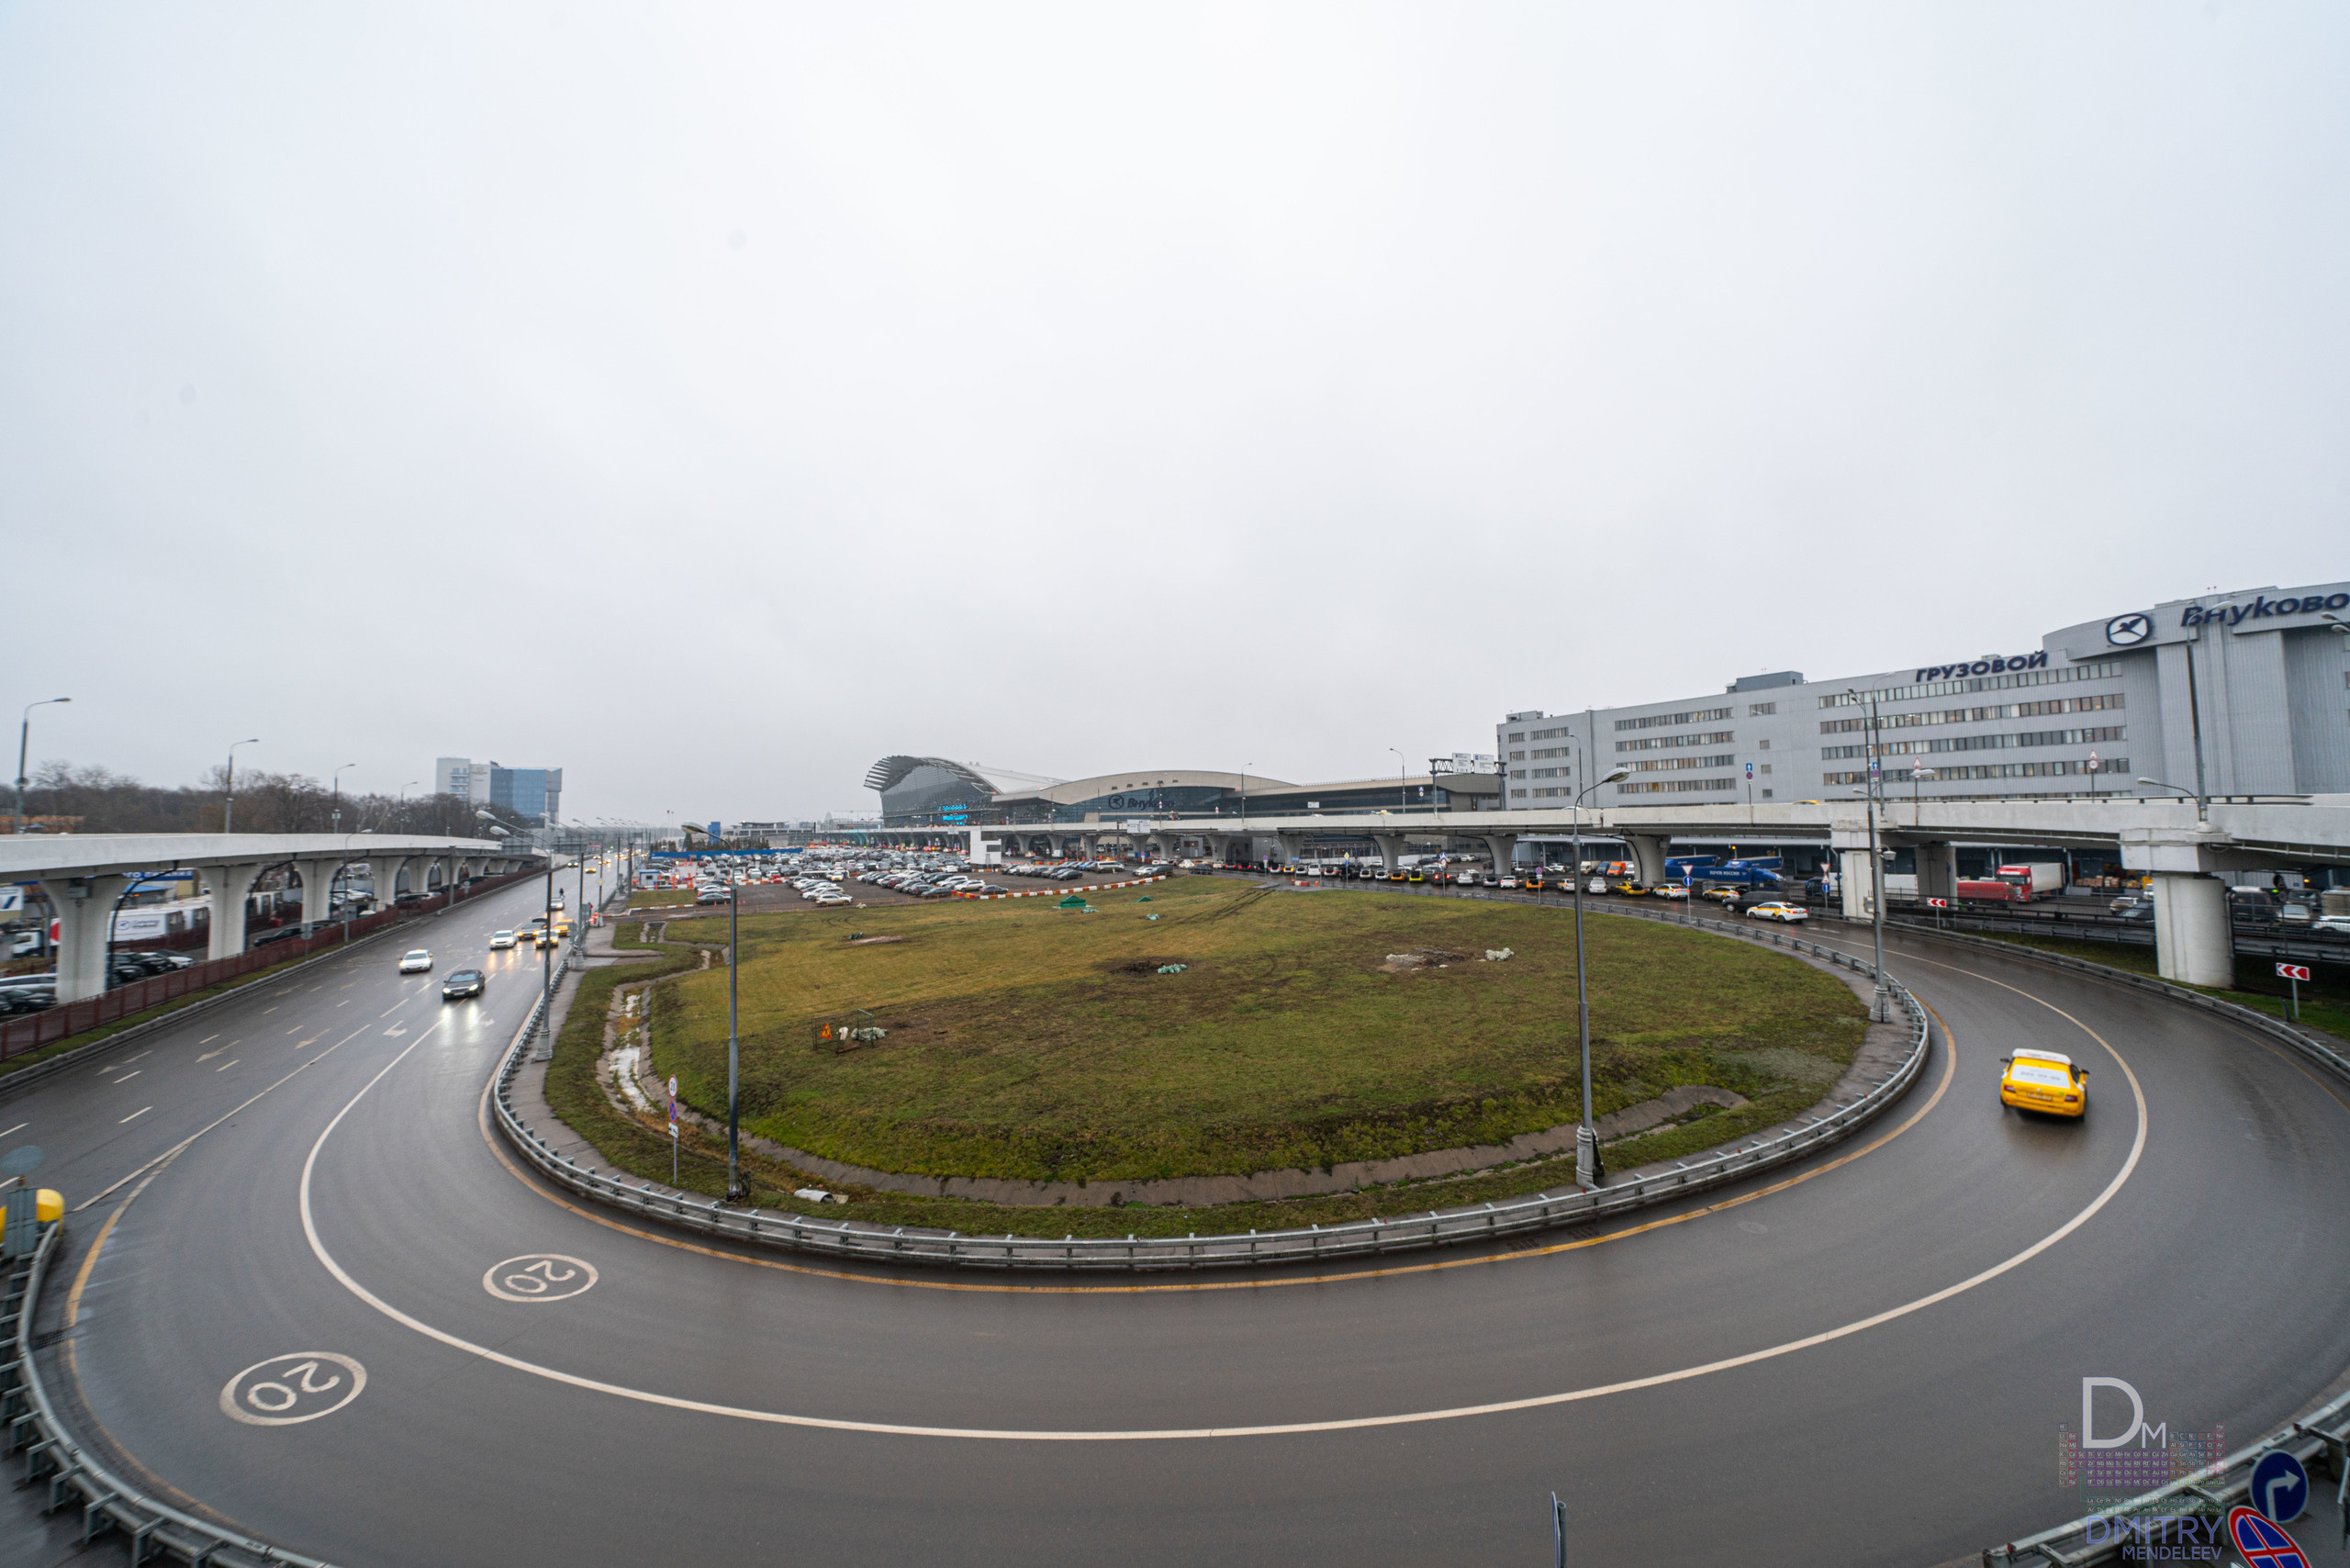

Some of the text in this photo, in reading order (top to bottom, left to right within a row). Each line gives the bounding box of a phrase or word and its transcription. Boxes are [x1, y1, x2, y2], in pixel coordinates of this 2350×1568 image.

[2180, 593, 2350, 627] Внуково
[1916, 650, 2048, 682] ГРУЗОВОЙ
[504, 1260, 576, 1294] 20
[247, 1361, 341, 1411] 20
